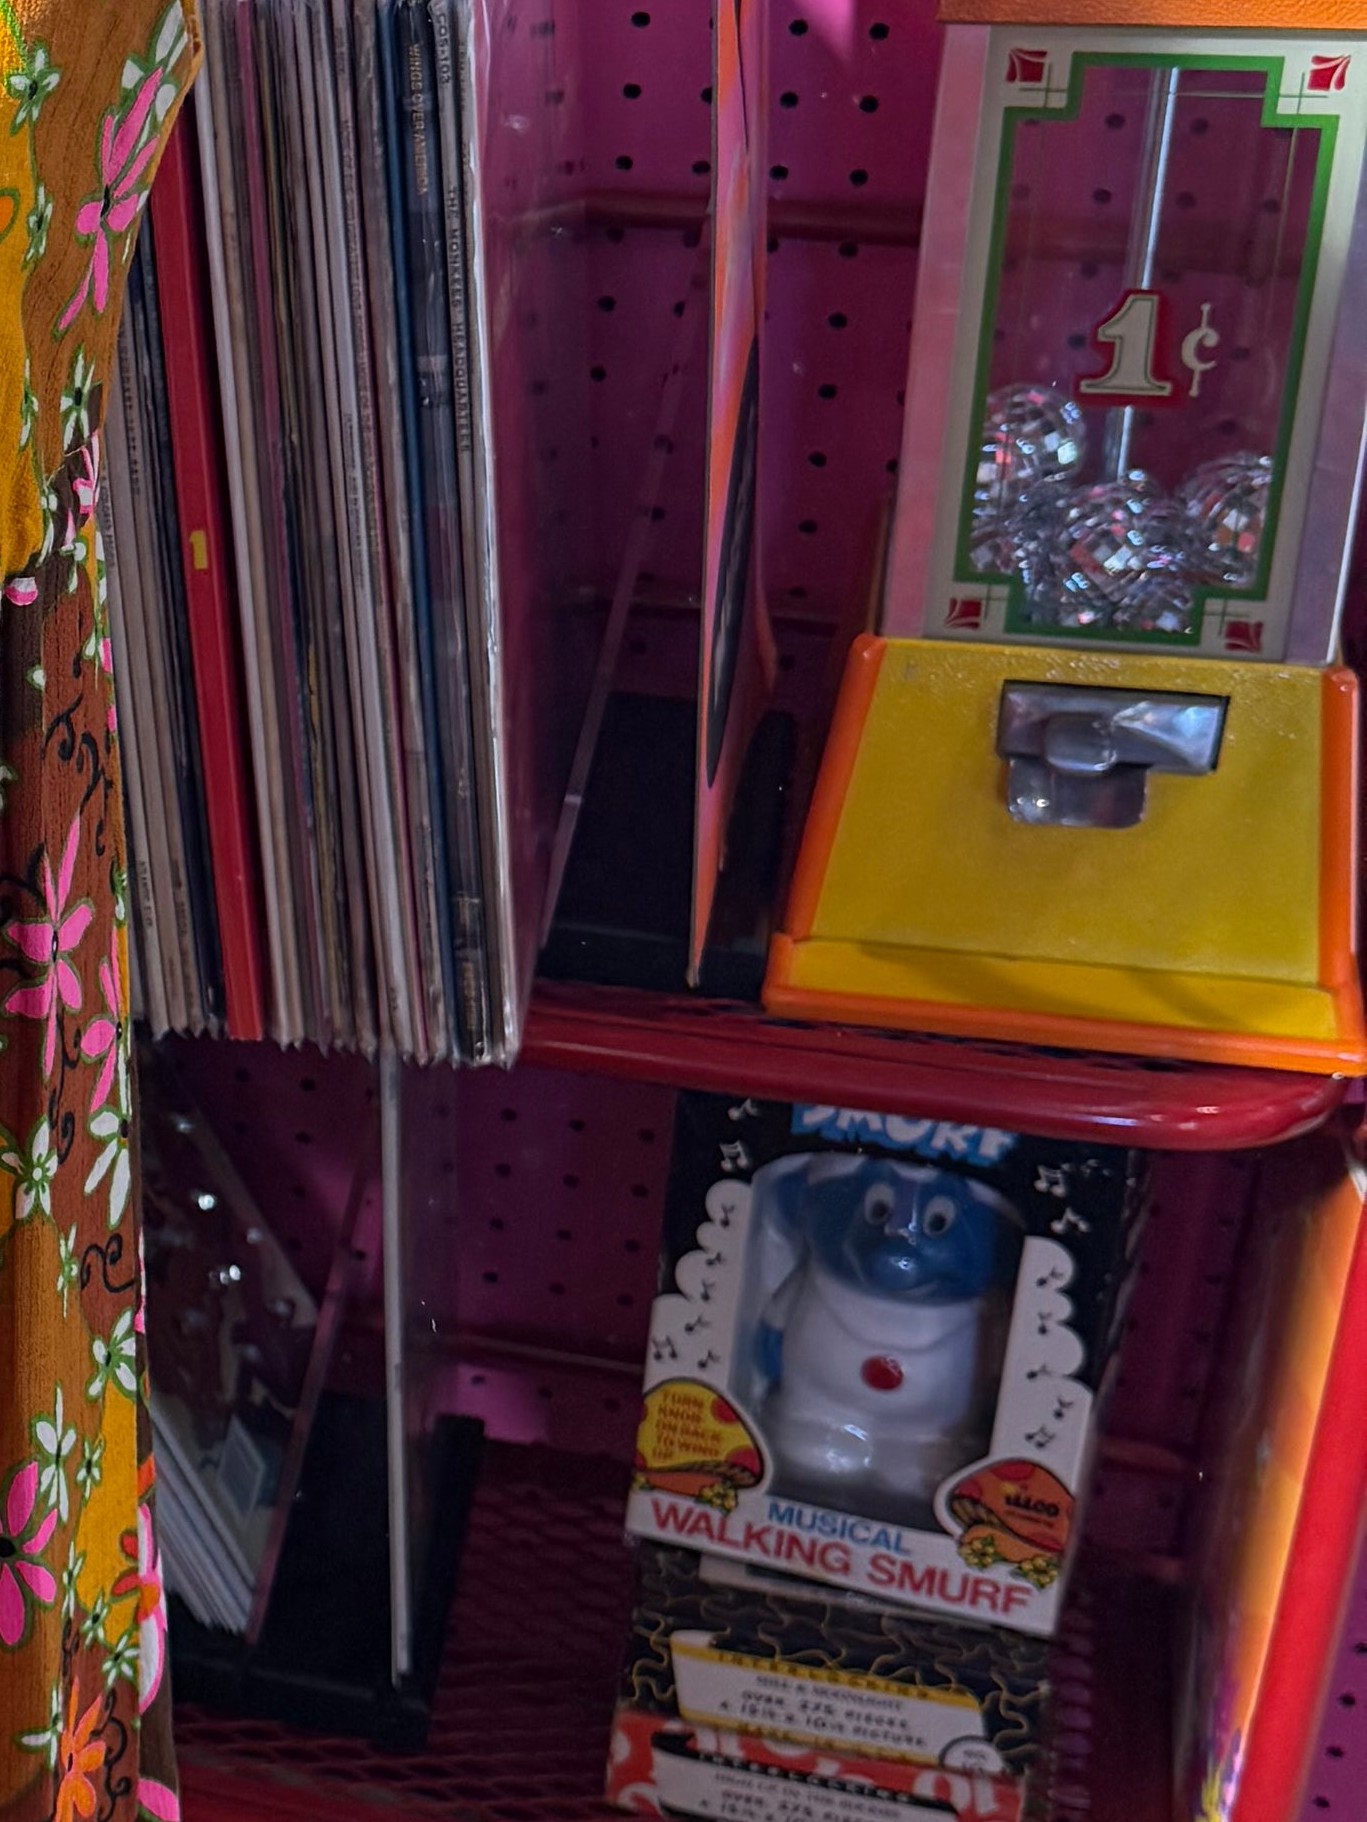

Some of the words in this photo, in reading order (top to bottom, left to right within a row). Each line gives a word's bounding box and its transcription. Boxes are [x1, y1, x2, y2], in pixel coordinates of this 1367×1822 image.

[408, 44, 422, 90] WINGS
[410, 92, 424, 131] OVER
[451, 321, 471, 454] HEADQUARTERS
[768, 1500, 910, 1555] MUSICAL
[651, 1498, 853, 1577] WALKING
[869, 1553, 1033, 1615] SMURF
